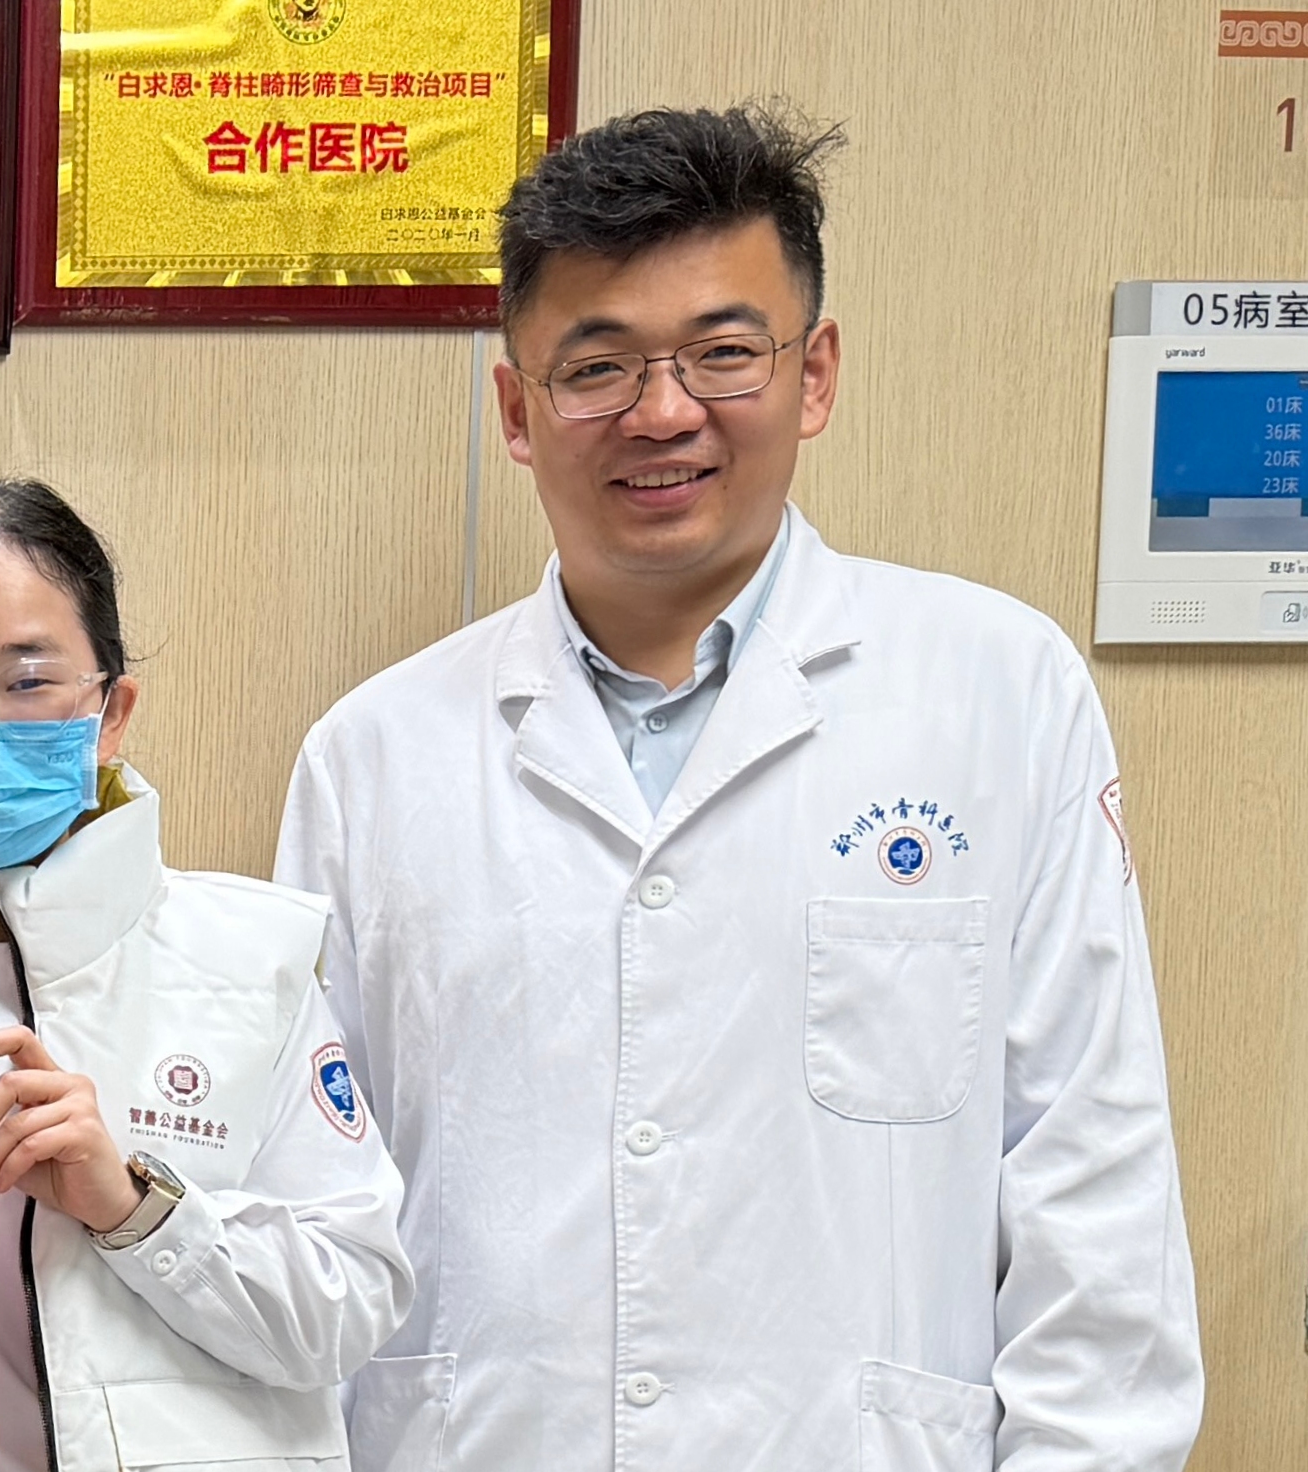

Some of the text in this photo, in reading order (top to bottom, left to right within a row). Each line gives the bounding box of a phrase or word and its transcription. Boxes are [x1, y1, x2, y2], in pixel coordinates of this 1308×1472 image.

[203, 120, 409, 174] 合作医院
[1183, 290, 1308, 329] 05病室
[1265, 396, 1303, 414] 01床
[1264, 423, 1302, 441] 36床
[1263, 450, 1301, 468] 20床
[1262, 477, 1300, 495] 23床
[128, 1106, 229, 1140] 智善公益基金会
